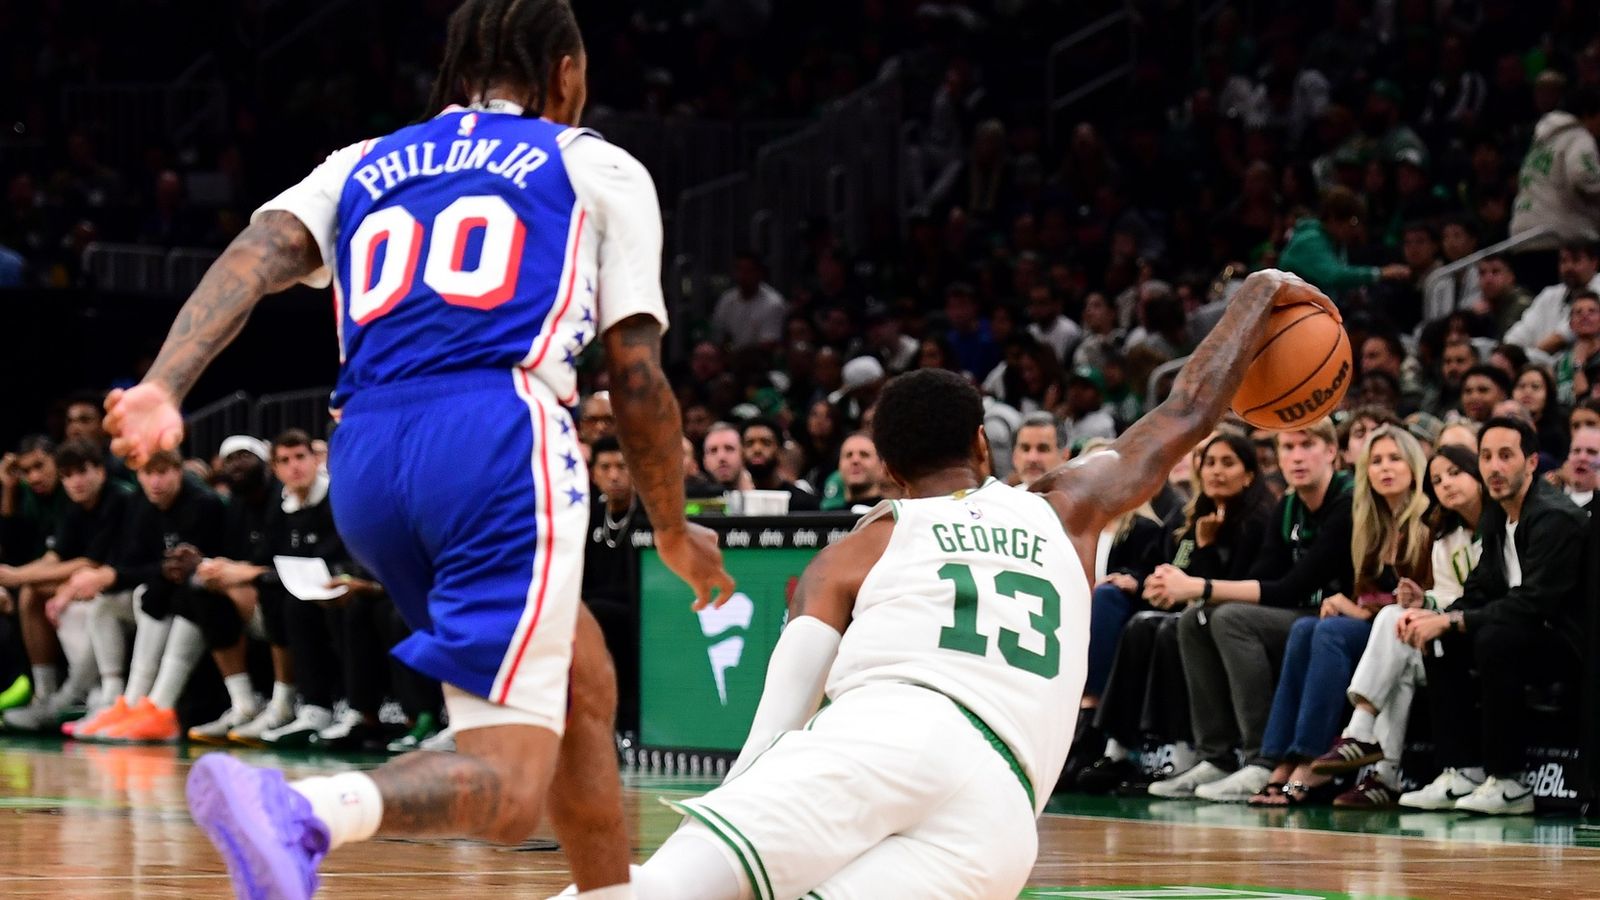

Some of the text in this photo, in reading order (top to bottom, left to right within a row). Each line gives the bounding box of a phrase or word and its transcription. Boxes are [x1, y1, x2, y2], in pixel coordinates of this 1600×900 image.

[353, 138, 549, 201] PHILON JR.
[349, 195, 527, 327] 00
[1274, 360, 1349, 423] Wilson
[932, 523, 1047, 567] GEORGE
[937, 562, 1061, 680] 13
